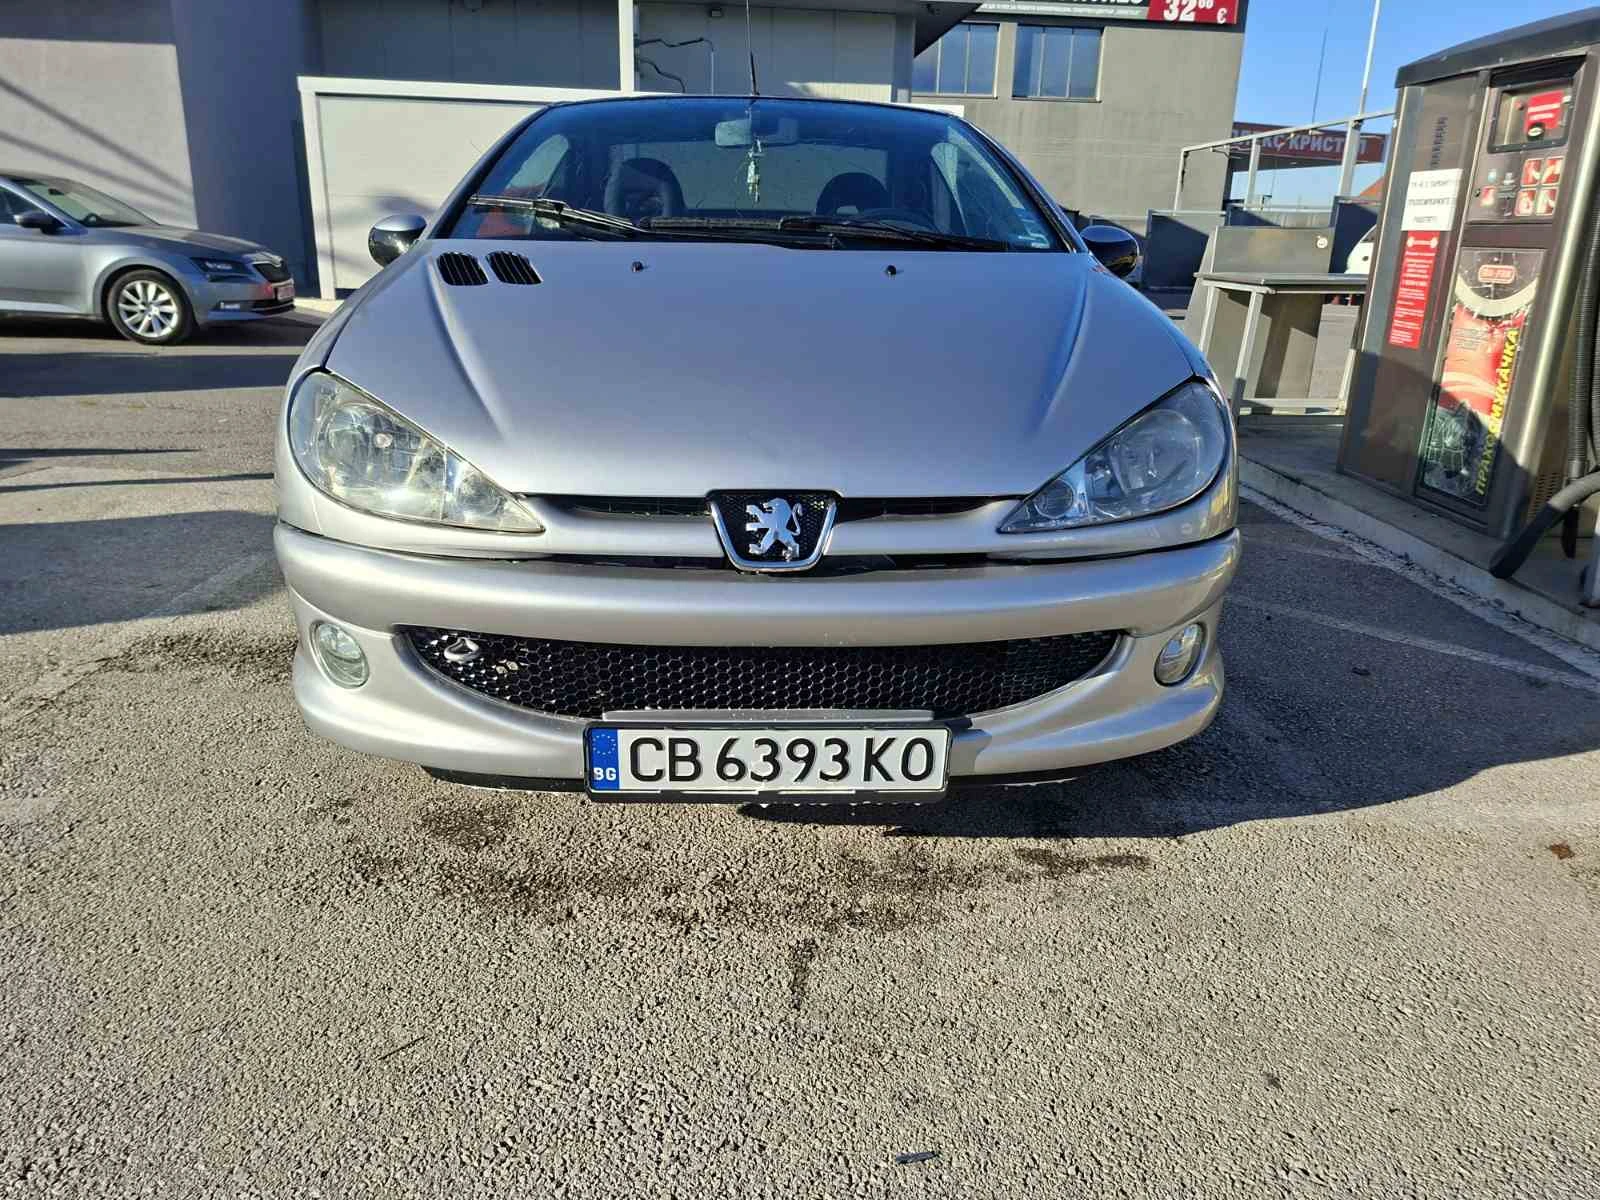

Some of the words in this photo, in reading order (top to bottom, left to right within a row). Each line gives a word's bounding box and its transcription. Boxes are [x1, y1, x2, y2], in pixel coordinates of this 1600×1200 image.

[1288, 133, 1368, 155] КРИСТЛ
[629, 737, 703, 783] CB
[715, 737, 850, 783] 6393
[863, 737, 935, 783] KO
[593, 767, 617, 781] BG
